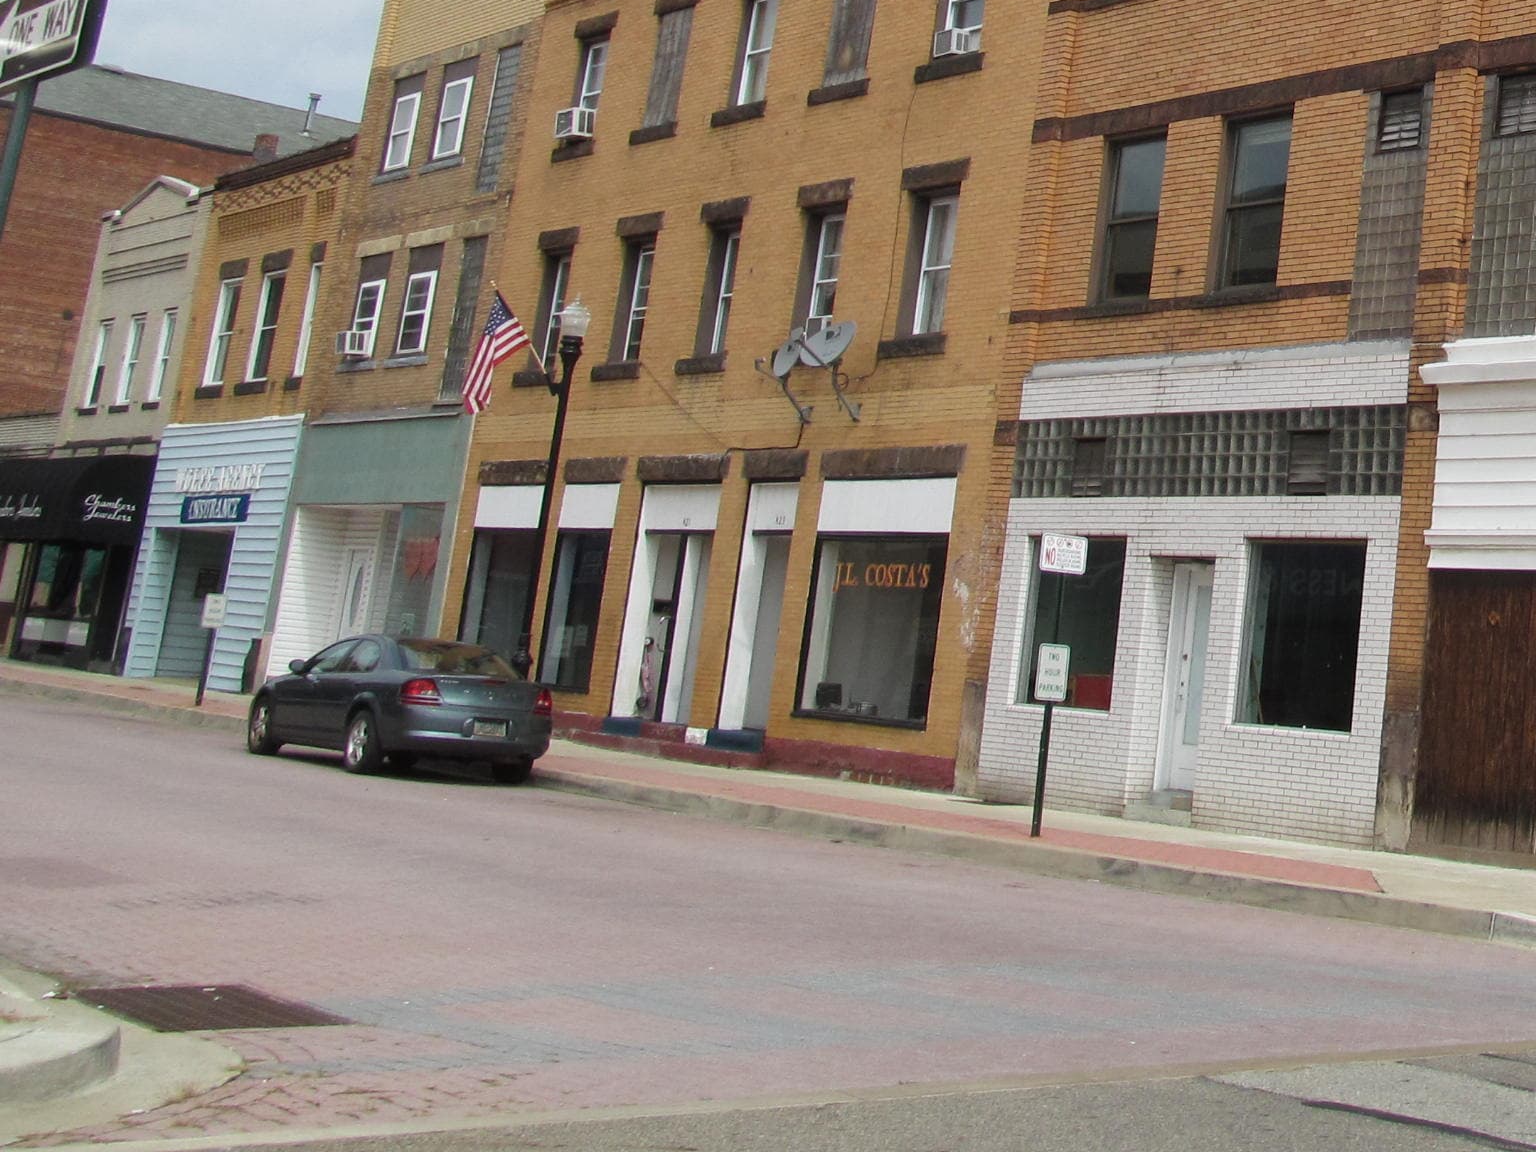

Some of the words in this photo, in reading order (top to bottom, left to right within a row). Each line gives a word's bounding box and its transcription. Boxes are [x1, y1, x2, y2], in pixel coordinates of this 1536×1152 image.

[7, 12, 39, 55] ONE
[84, 494, 136, 511] Chambers
[188, 498, 241, 520] INSURANCE
[83, 508, 132, 522] Jewelers
[1044, 547, 1056, 565] NO
[865, 563, 931, 588] COSTA'S
[1048, 652, 1060, 662] TWO
[1044, 668, 1061, 677] HOUR
[1038, 682, 1064, 694] PARKING
